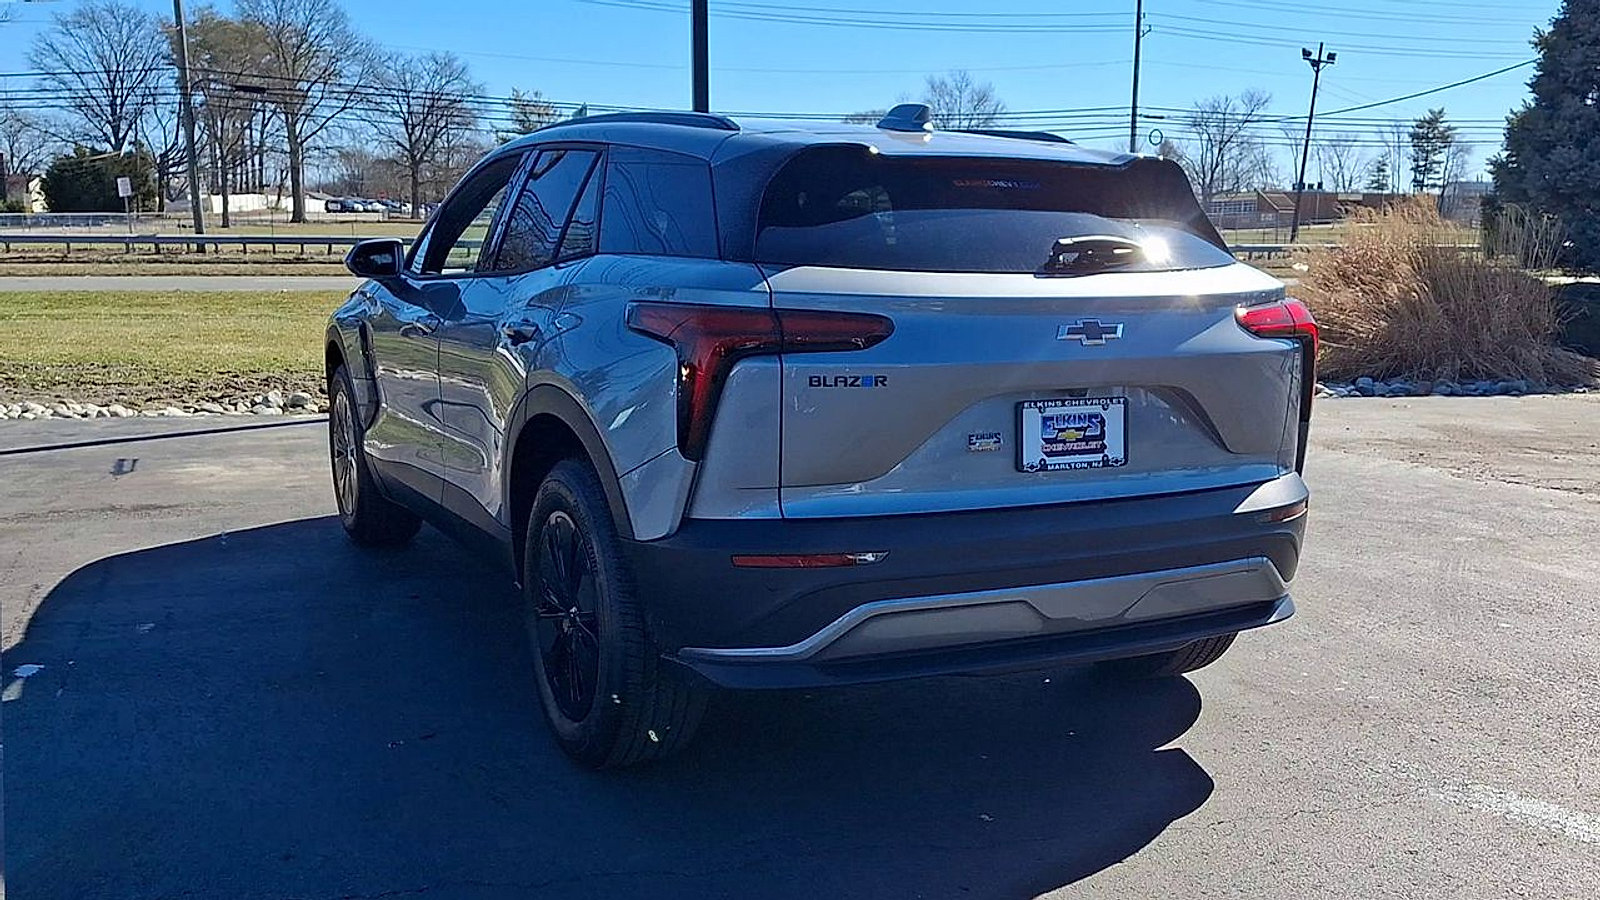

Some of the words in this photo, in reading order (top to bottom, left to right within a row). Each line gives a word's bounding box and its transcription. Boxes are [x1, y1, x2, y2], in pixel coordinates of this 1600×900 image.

[808, 375, 888, 388] BLAZER
[1023, 399, 1063, 408] ELKINS
[1065, 397, 1125, 407] CHEVROLET
[1041, 412, 1102, 438] ELKINS
